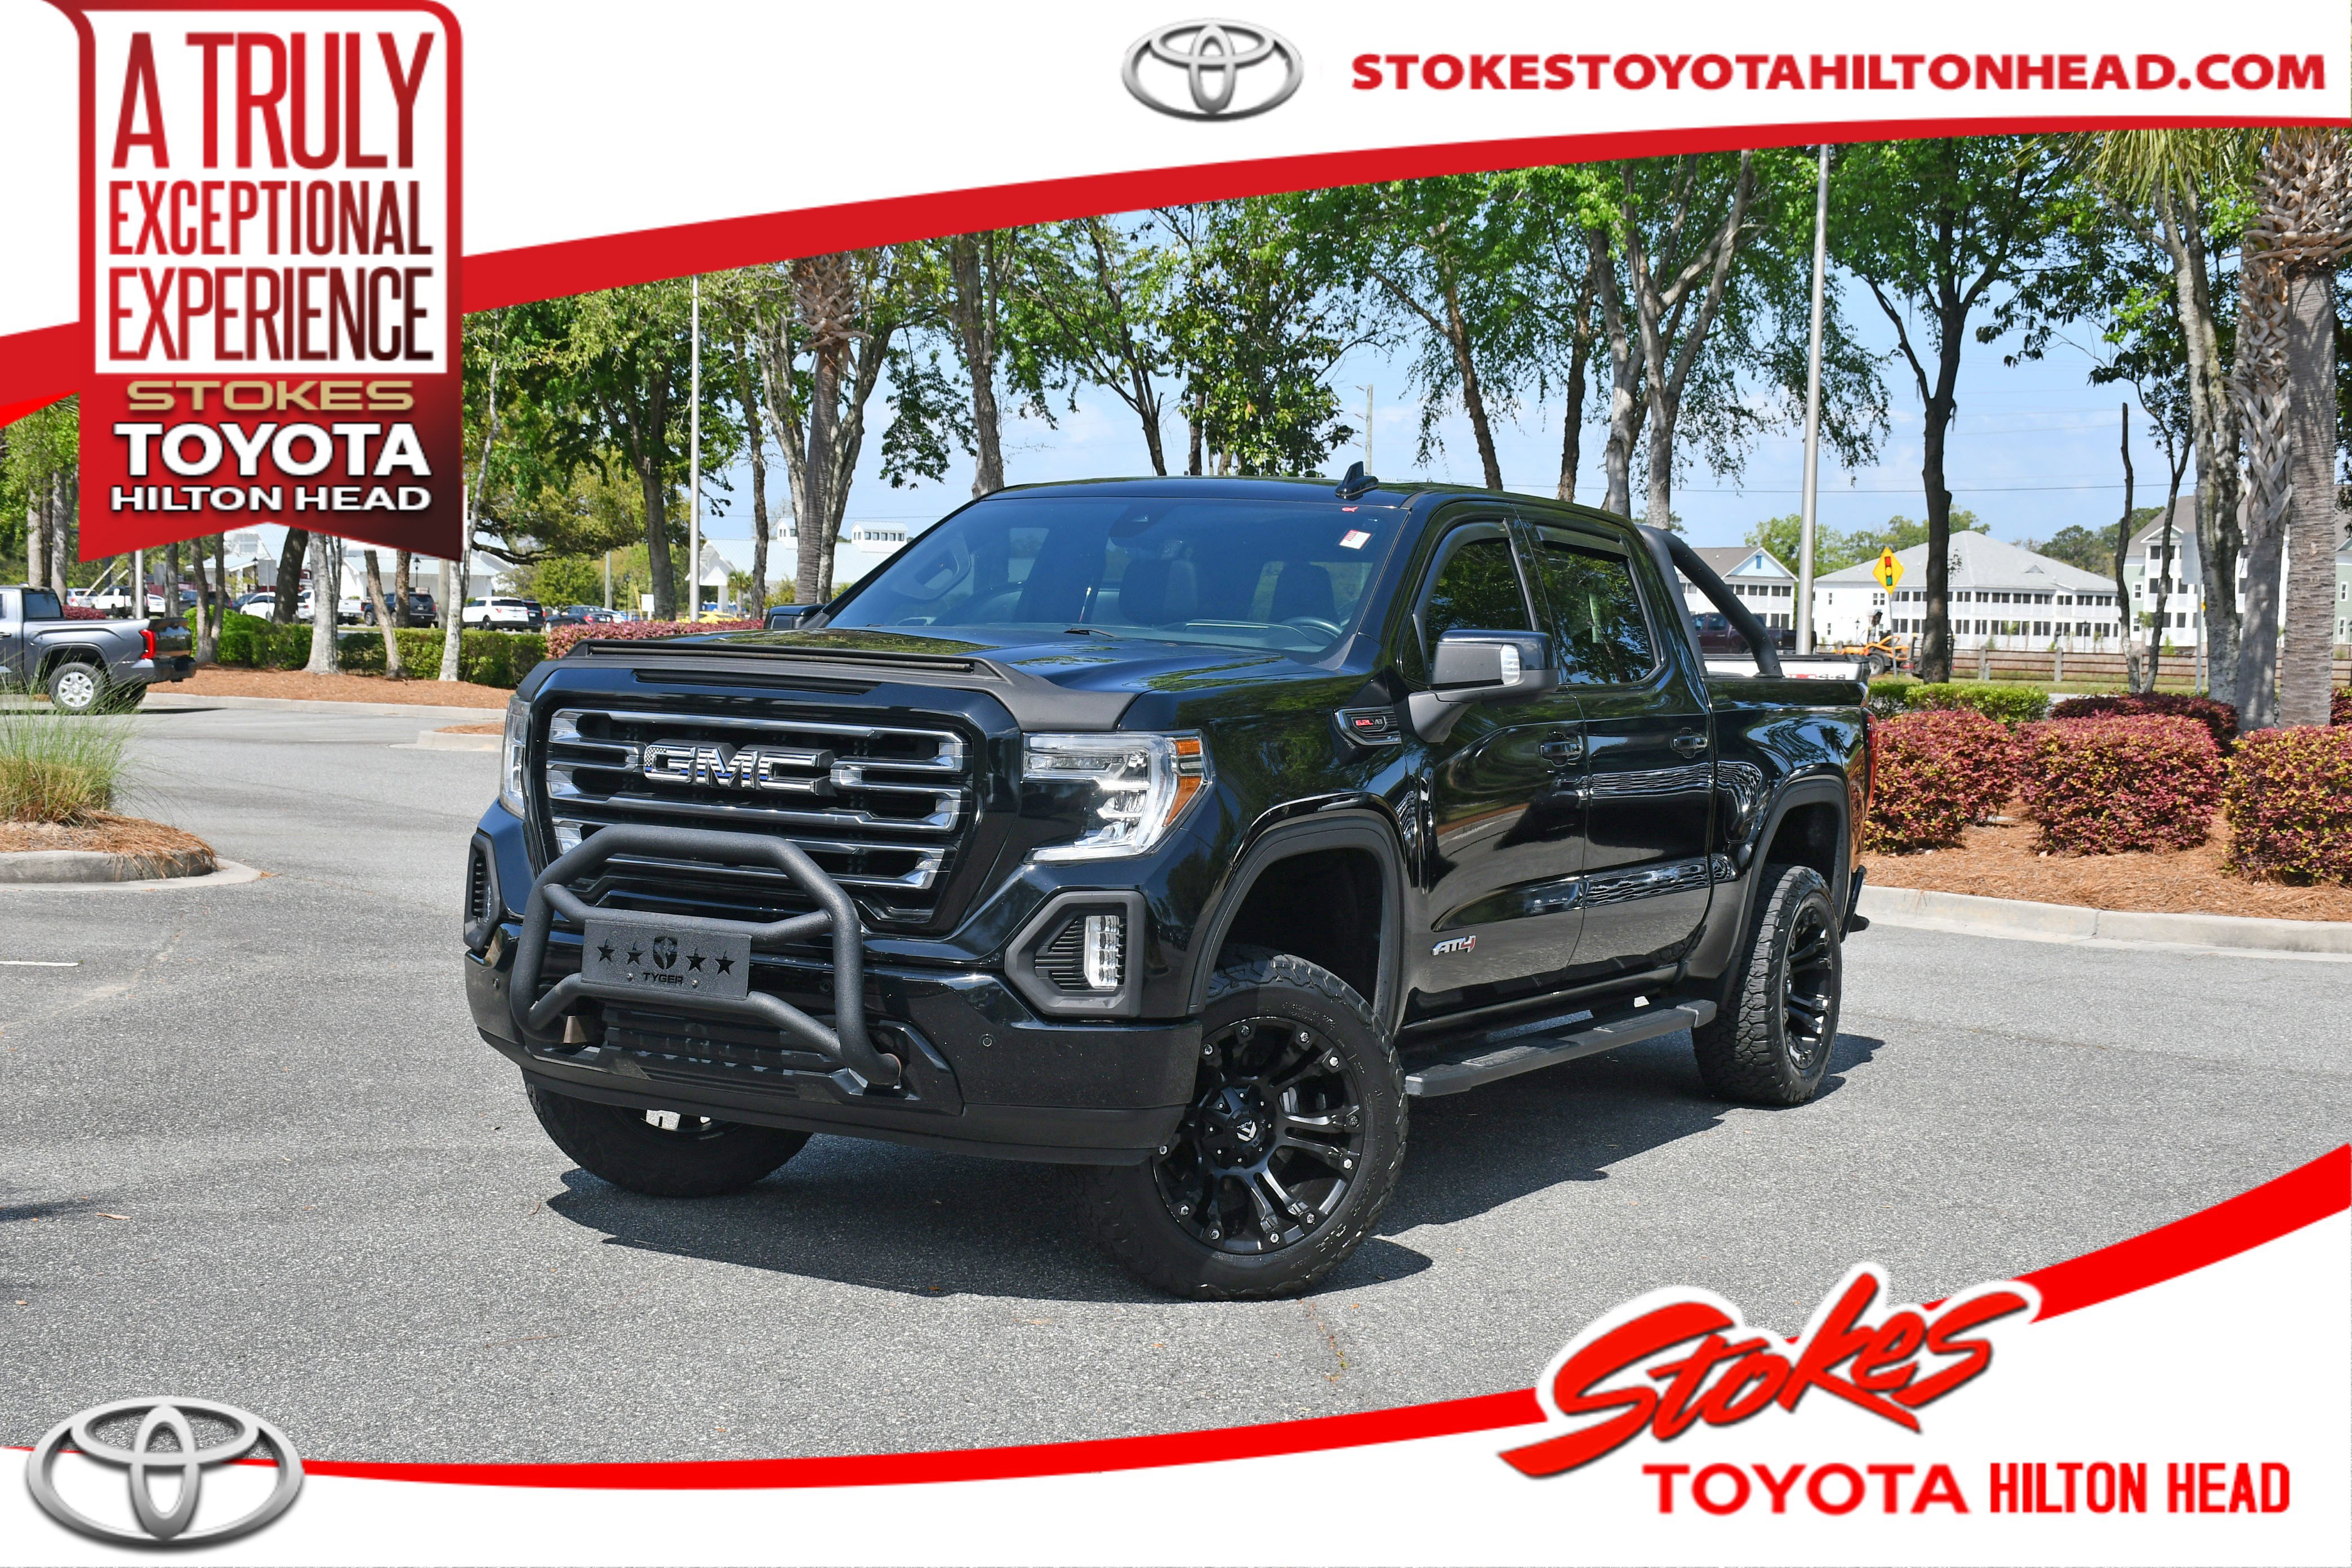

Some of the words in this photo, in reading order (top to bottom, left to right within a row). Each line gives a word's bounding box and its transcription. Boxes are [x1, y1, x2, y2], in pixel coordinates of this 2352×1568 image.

[643, 741, 821, 792] GMC
[1431, 934, 1476, 956] AT4
[643, 972, 683, 985] TYGER
